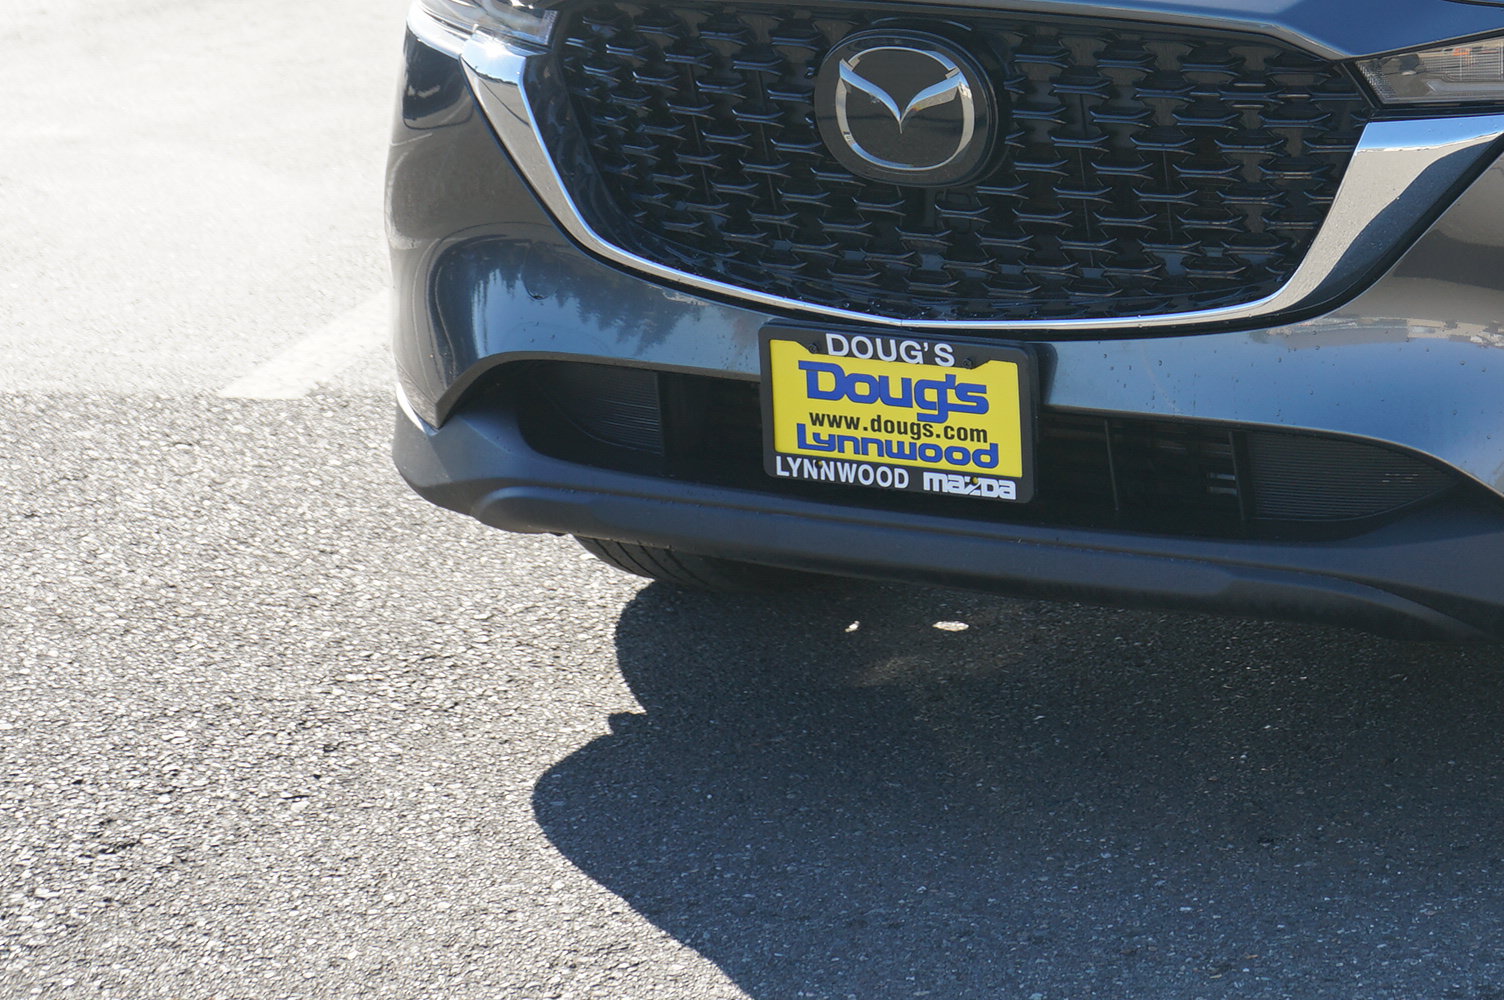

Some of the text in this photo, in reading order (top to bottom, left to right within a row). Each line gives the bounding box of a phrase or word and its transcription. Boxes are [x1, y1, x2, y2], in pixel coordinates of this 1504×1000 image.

[825, 333, 956, 367] DOUG'S
[798, 360, 990, 424] Doug's
[808, 412, 989, 444] www.dougs.com
[796, 423, 999, 469] Lynnwood
[775, 455, 910, 489] LYNNWOOD
